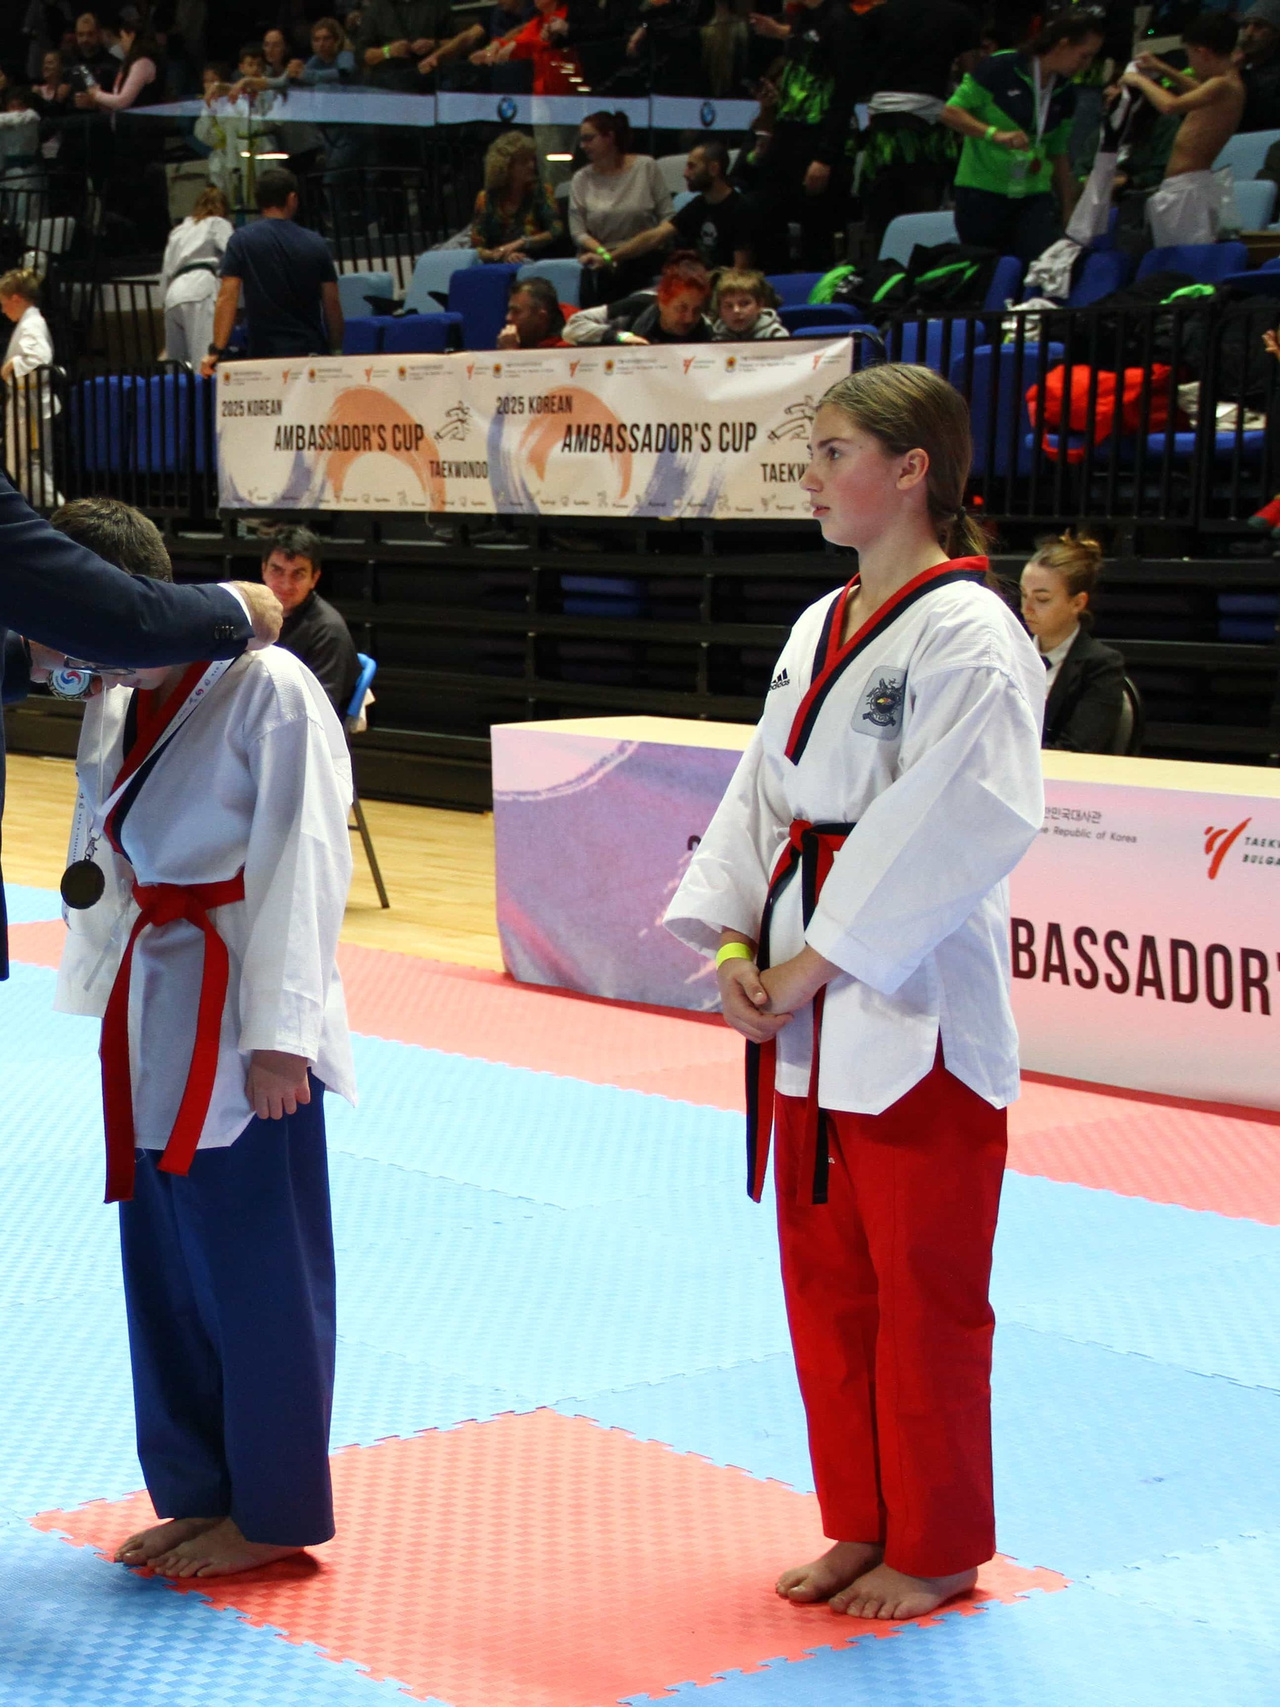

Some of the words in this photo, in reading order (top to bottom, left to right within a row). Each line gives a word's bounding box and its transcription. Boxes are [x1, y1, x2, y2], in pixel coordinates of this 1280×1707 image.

[222, 400, 245, 417] 2025
[247, 399, 282, 416] KOREAN
[496, 398, 524, 415] 2025
[529, 396, 572, 414] KOREAN
[274, 424, 387, 451] AMBASSADOR'S
[392, 423, 424, 451] CUP
[561, 423, 712, 453] AMBASSADOR'S
[719, 422, 757, 452] CUP
[429, 460, 488, 479] TAEKWONDO
[1053, 826, 1091, 838] Republic
[1096, 831, 1106, 840] of
[1110, 832, 1137, 843] Korea
